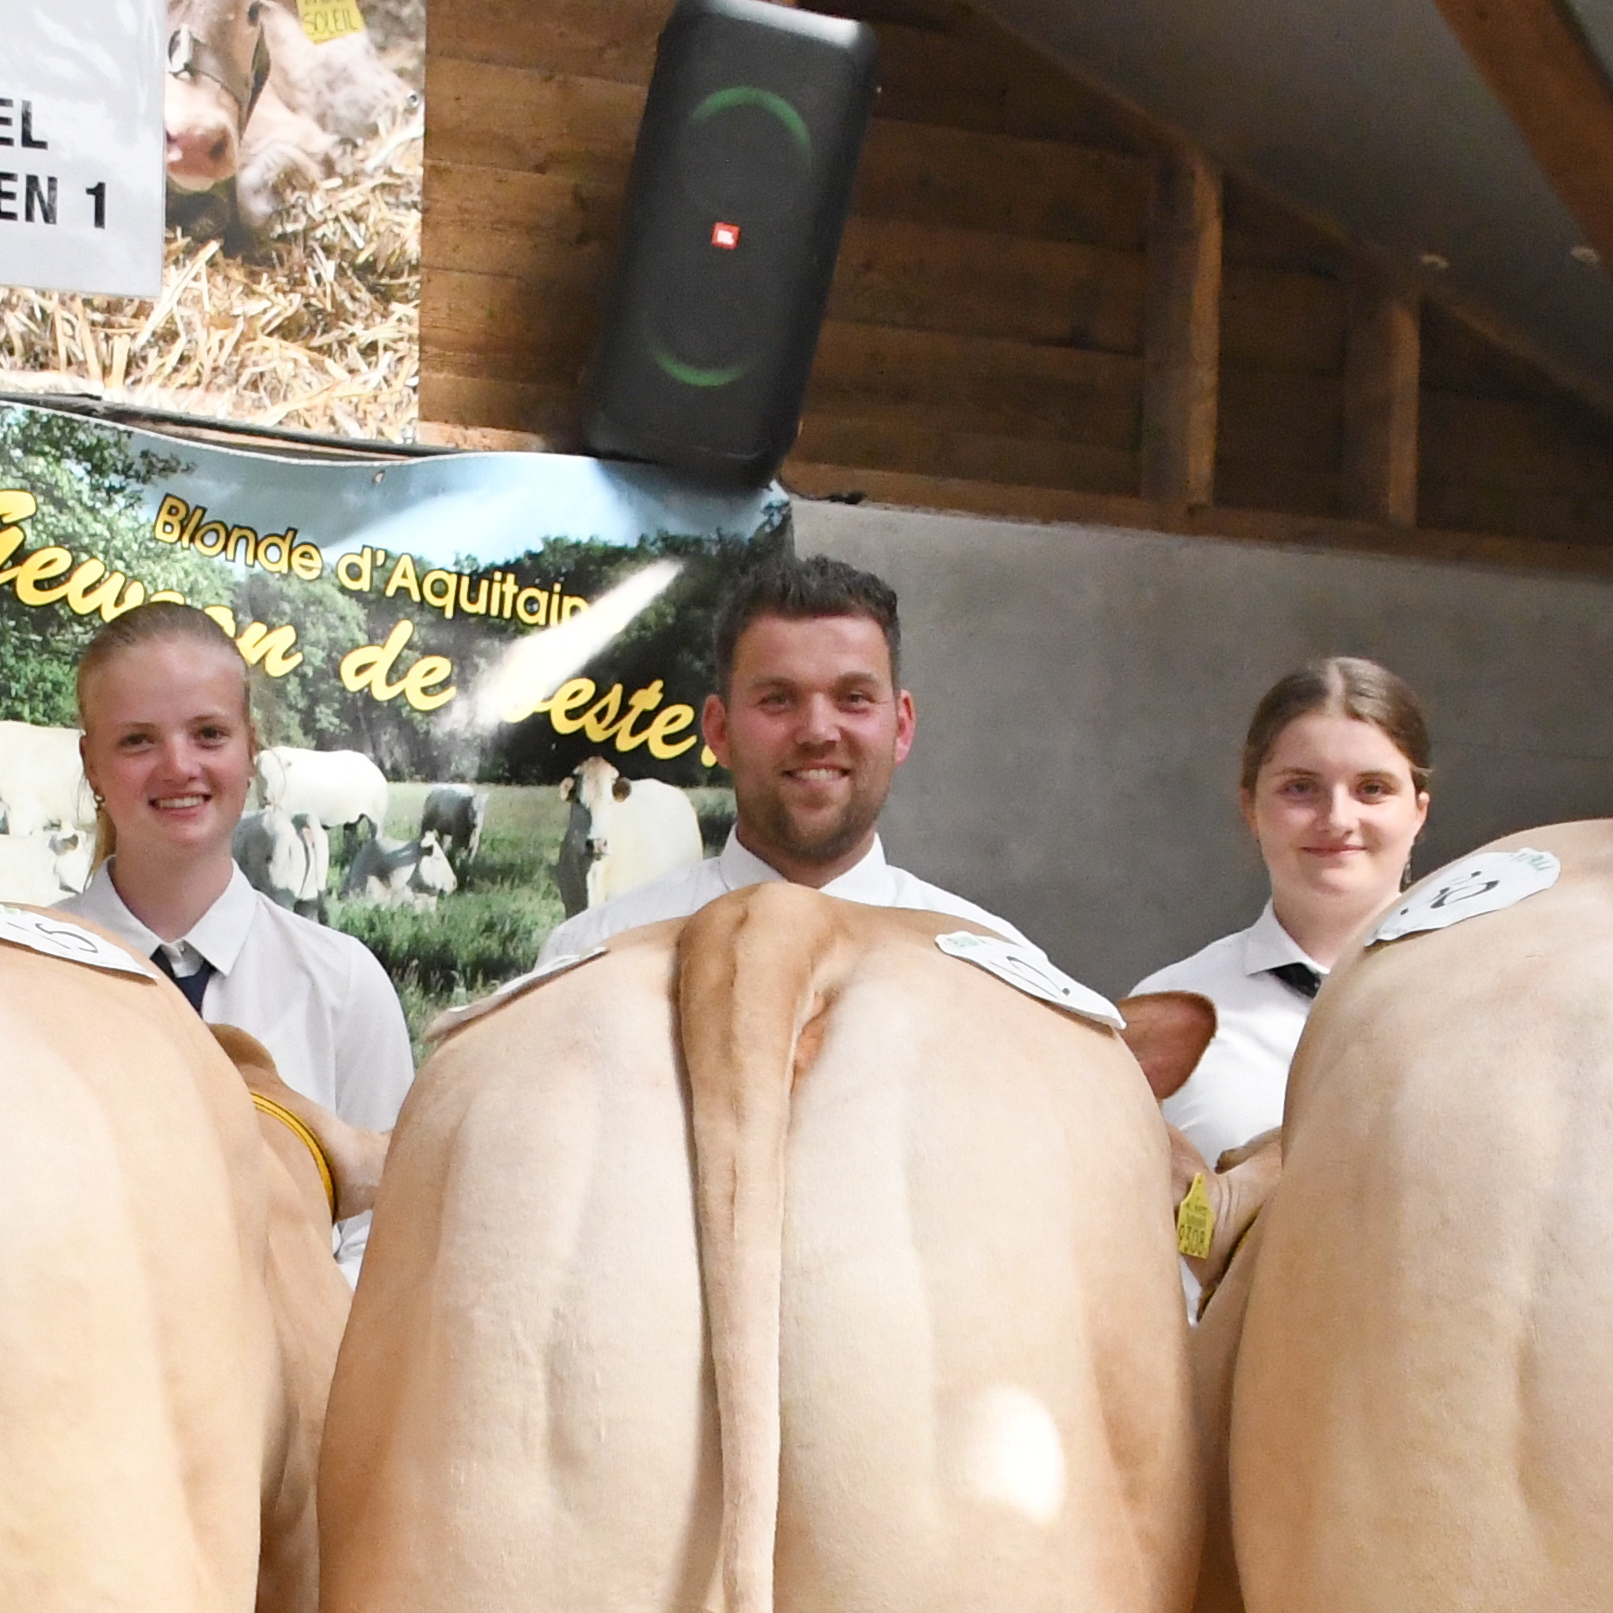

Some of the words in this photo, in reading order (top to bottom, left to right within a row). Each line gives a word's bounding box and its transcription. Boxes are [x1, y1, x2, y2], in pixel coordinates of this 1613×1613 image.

[85, 181, 107, 230] 1
[153, 493, 325, 582] Blonde
[336, 544, 613, 628] d'Aquitain
[339, 618, 458, 712] de
